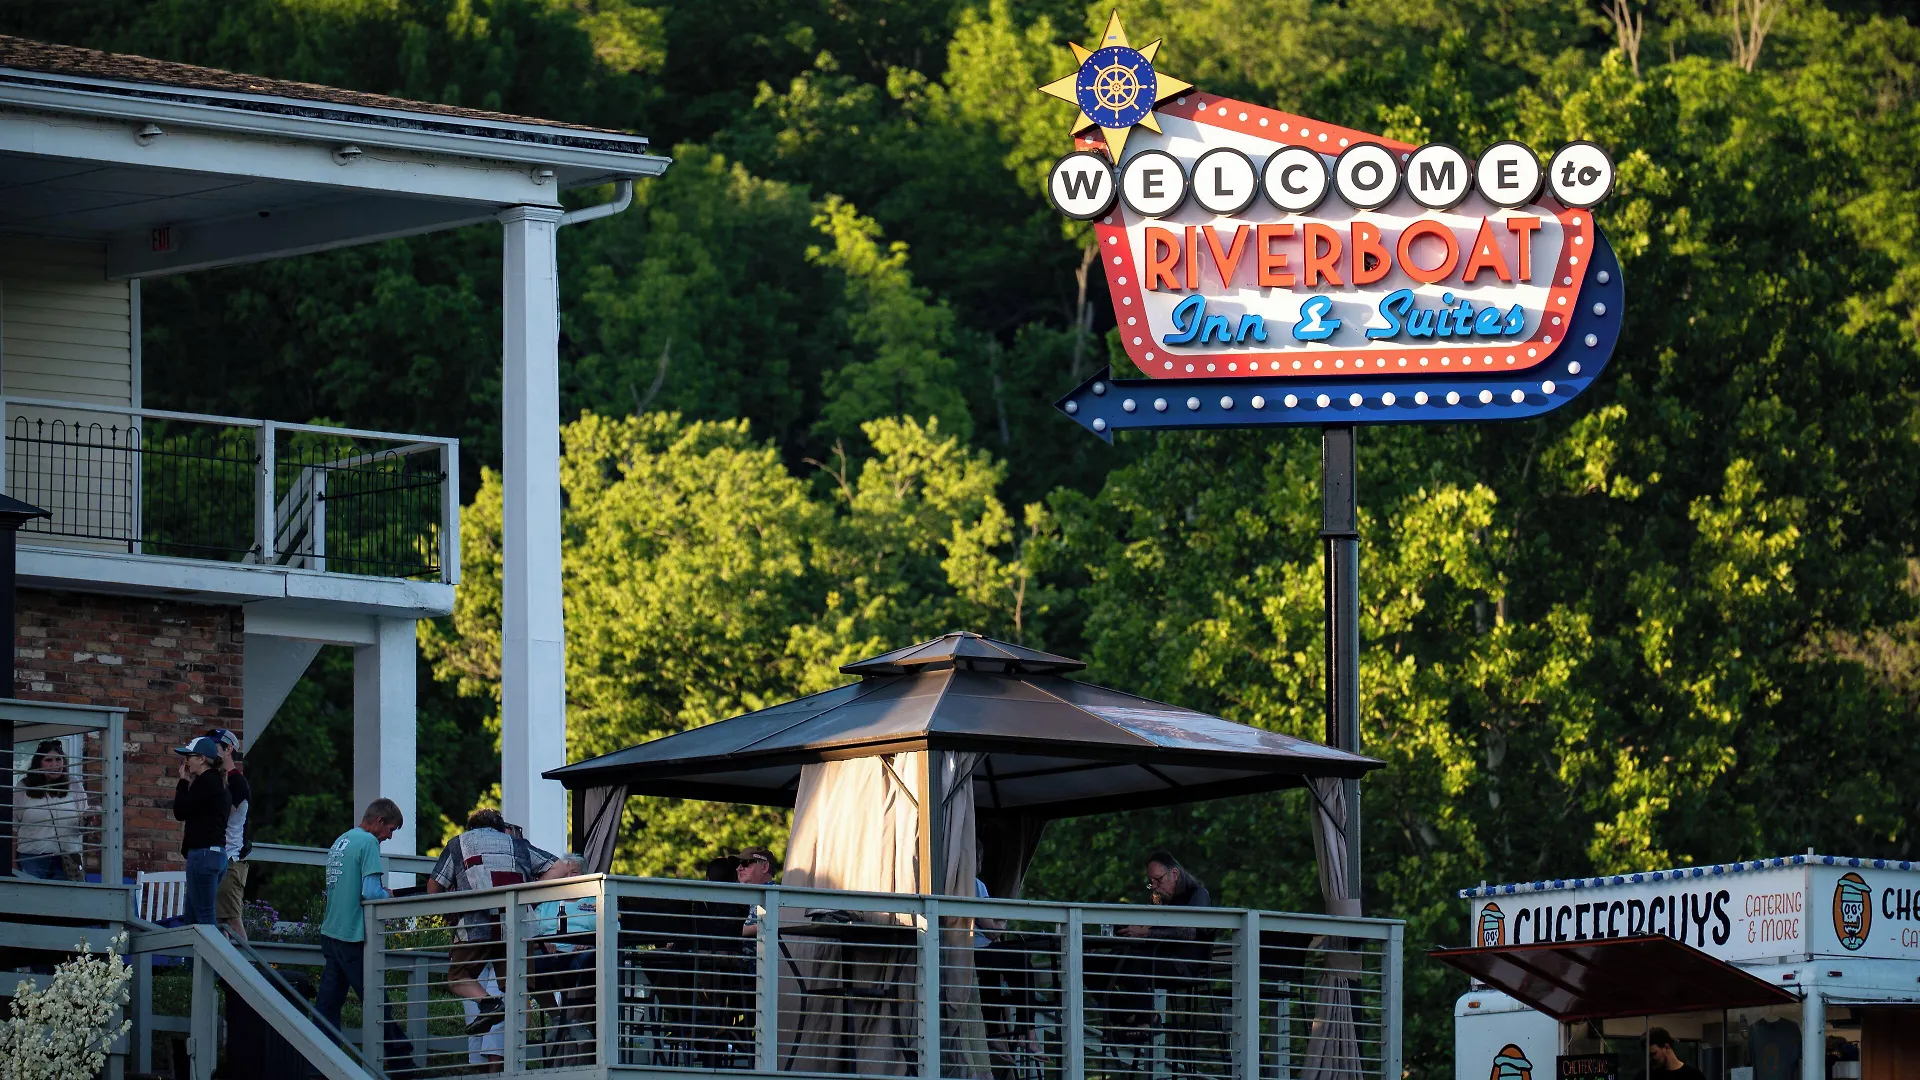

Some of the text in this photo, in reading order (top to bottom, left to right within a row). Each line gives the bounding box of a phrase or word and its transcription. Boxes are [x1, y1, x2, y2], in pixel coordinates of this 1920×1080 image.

[1060, 159, 1602, 200] WELCOME to
[152, 227, 171, 252] EXIT
[1145, 215, 1542, 291] RIVERBOAT
[1162, 289, 1525, 345] Inn & Suites
[1745, 891, 1802, 918] CATERING
[1747, 918, 1799, 943] & MORE
[1901, 927, 1920, 949] CA
